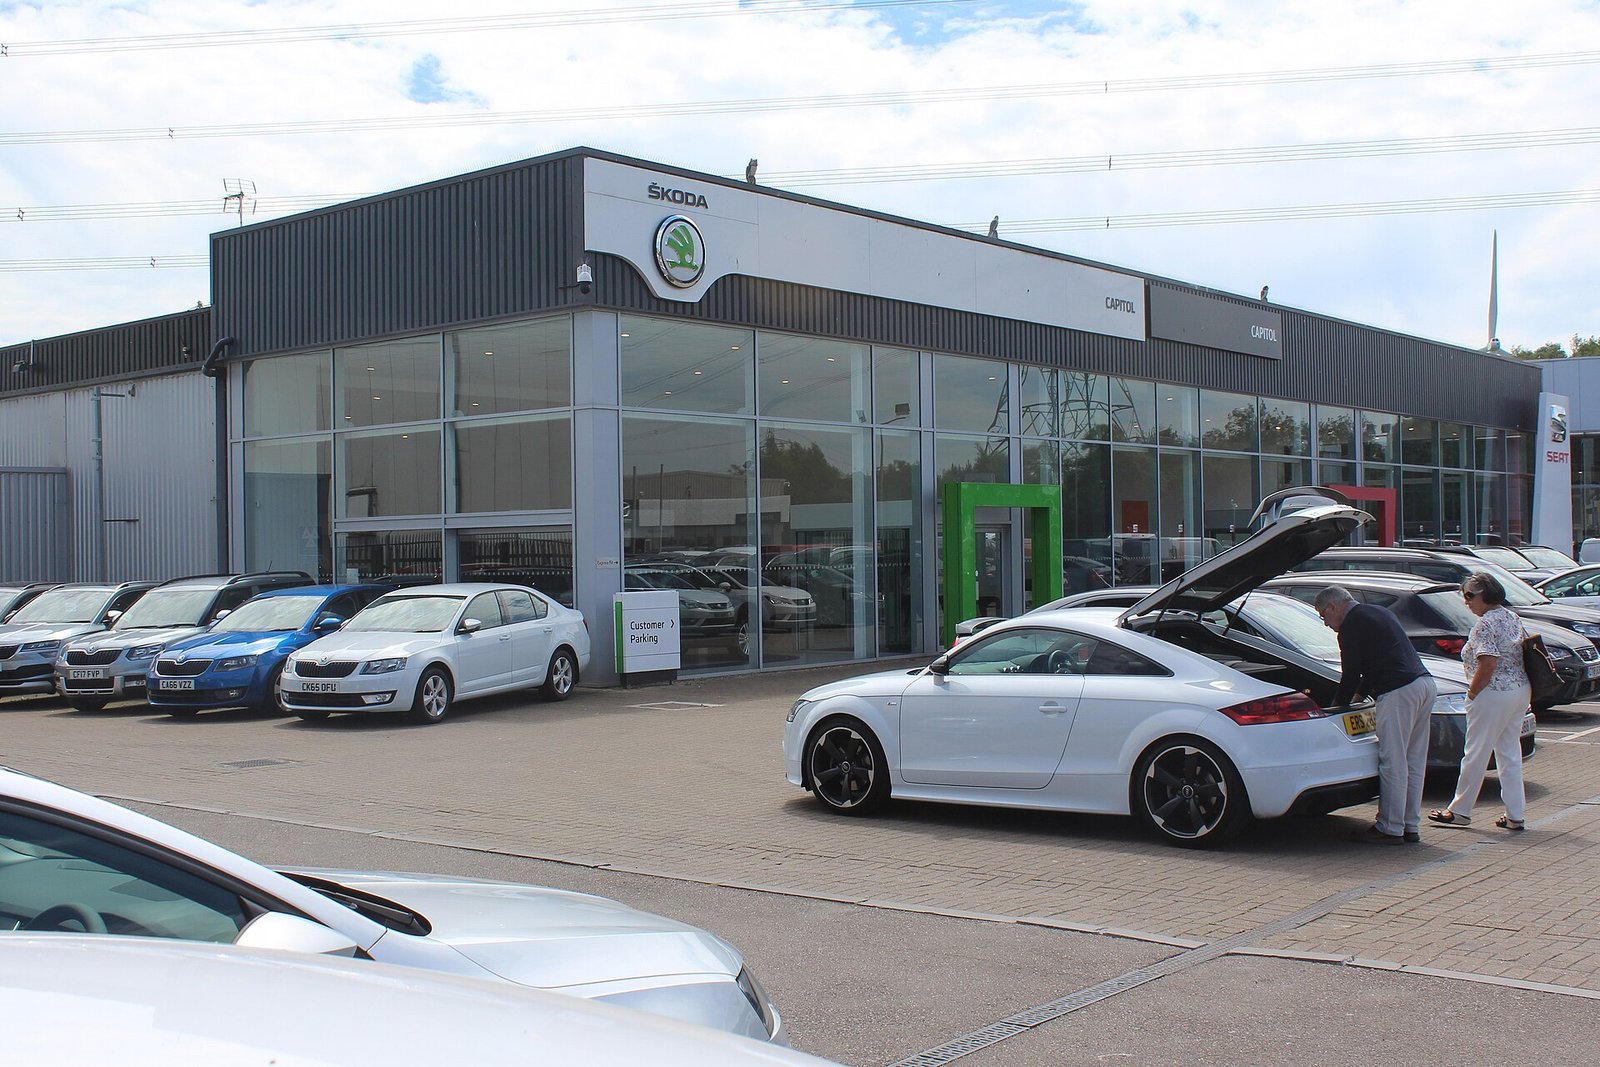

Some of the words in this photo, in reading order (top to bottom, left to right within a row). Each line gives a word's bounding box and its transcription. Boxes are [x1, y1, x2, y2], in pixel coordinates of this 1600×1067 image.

[648, 182, 709, 209] ŠKODA
[1105, 296, 1136, 314] CAPITOL
[1251, 325, 1278, 342] CAPITOL
[1546, 451, 1569, 463] SEAT
[630, 621, 665, 630] Customer
[630, 634, 659, 644] Parking
[73, 670, 86, 678] CF17
[87, 670, 100, 678] FVP
[161, 680, 178, 689] CA66
[178, 680, 192, 689] VZZ
[301, 683, 320, 692] CK65
